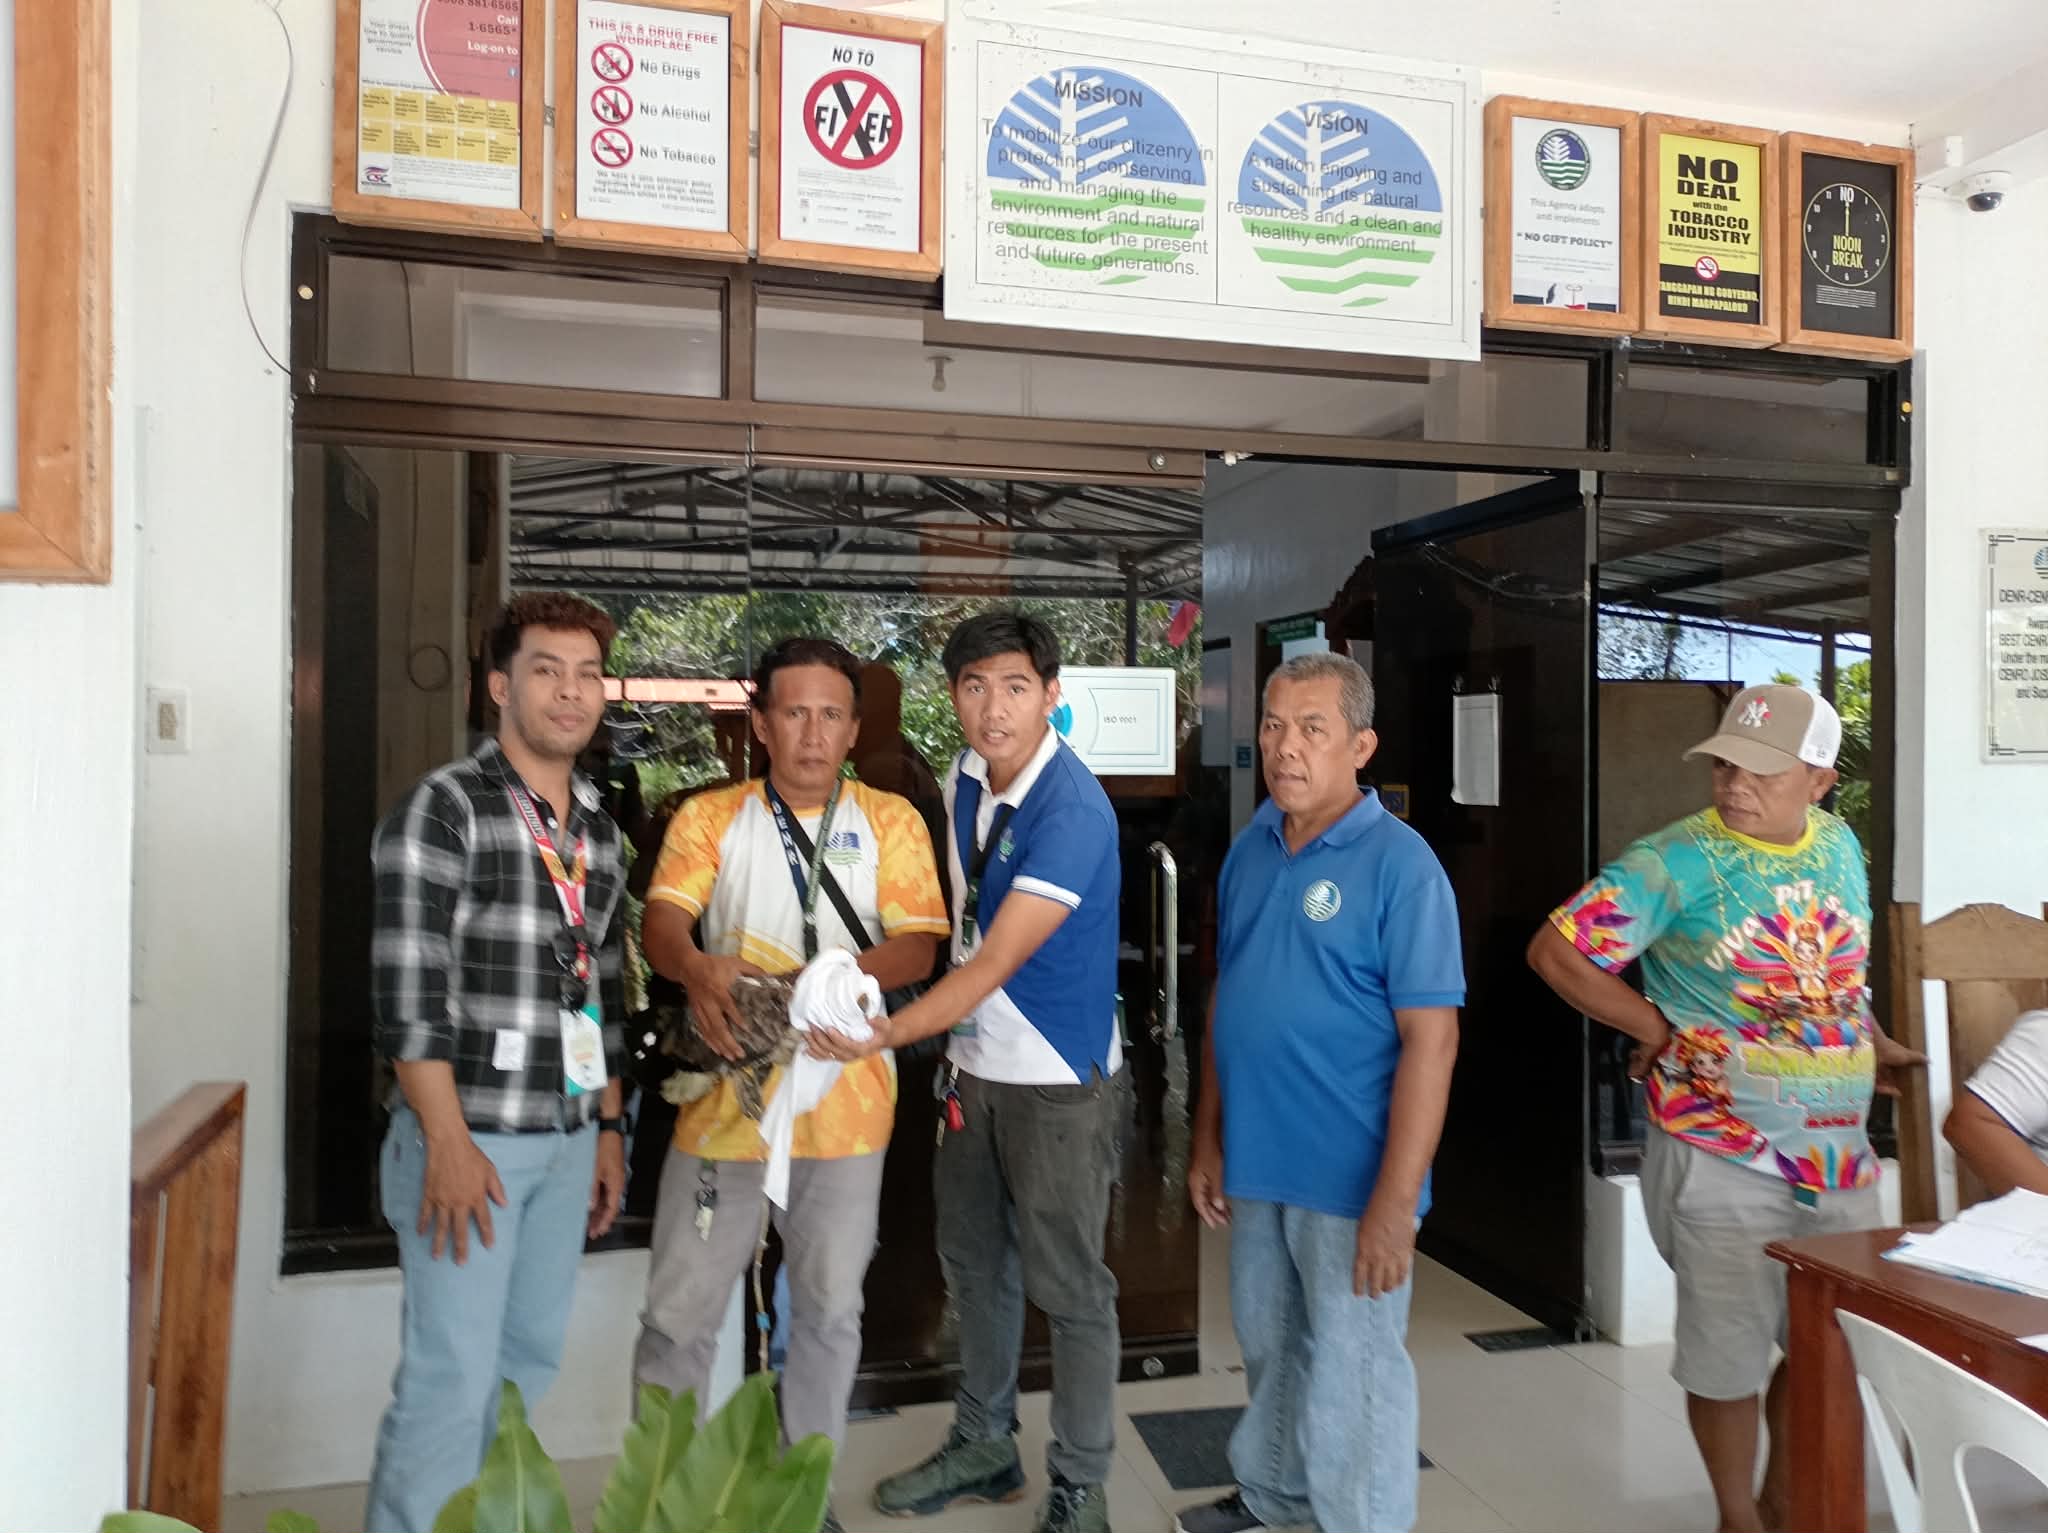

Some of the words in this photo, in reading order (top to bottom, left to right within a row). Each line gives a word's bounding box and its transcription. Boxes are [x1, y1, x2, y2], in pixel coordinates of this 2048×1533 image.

[497, 15, 519, 25] Call
[588, 20, 617, 31] THIS
[621, 22, 633, 33] IS
[636, 24, 645, 34] A
[648, 26, 683, 40] DRUG
[687, 32, 719, 45] FREE
[468, 40, 504, 54] Log-on
[507, 45, 519, 56] to
[616, 34, 693, 52] WORKPLACE
[832, 47, 853, 64] NO
[857, 50, 874, 67] TO
[640, 60, 658, 74] No
[662, 63, 701, 81] Drugs
[1055, 79, 1143, 107] MISSION
[640, 103, 658, 116] No
[661, 104, 711, 123] Alcohol
[1304, 111, 1369, 135] VISION
[982, 118, 1003, 138] To
[1008, 126, 1081, 147] mobilize
[1088, 135, 1116, 150] our
[1122, 138, 1193, 163] citizenry
[1199, 145, 1214, 160] in
[640, 146, 658, 160] No
[662, 147, 717, 166] Tobacco
[366, 174, 388, 183] CSC
[1248, 152, 1259, 167] A
[1264, 153, 1315, 174] nation
[1321, 161, 1387, 185] enjoying
[1392, 168, 1422, 185] and
[1678, 153, 1739, 184] NO
[1020, 174, 1052, 191] and
[1059, 180, 1145, 205] managing
[1152, 188, 1177, 205] the
[1251, 178, 1336, 203] sustaining
[1340, 188, 1359, 203] its
[1364, 191, 1418, 209] natural
[1677, 179, 1741, 202] DEAL
[1825, 190, 1832, 200] 11
[1839, 186, 1855, 203] NO
[991, 197, 1102, 222] environment
[1108, 210, 1139, 226] and
[1146, 213, 1205, 233] natural
[1692, 201, 1712, 210] with
[1713, 203, 1728, 211] the
[1813, 203, 1821, 213] 10
[1227, 198, 1309, 222] resources
[1315, 208, 1344, 225] and
[1350, 214, 1360, 227] a
[1364, 213, 1408, 233] clean
[1412, 218, 1442, 235] and
[1670, 209, 1749, 231] TOBACCO
[987, 219, 1076, 242] resources
[1082, 227, 1104, 244] for
[1111, 231, 1137, 248] the
[1144, 236, 1208, 255] present
[1250, 221, 1311, 247] healthy
[1525, 232, 1540, 242] NO
[1542, 233, 1568, 244] GIFT
[1668, 223, 1751, 245] INDUSTRY
[1807, 223, 1812, 233] 9
[1833, 234, 1862, 253] NOON
[1881, 235, 1885, 243] 3
[995, 244, 1029, 260] and
[1036, 246, 1086, 266] future
[1093, 252, 1200, 276] generations.
[1832, 251, 1864, 269] BREAK
[1875, 258, 1880, 267] 4
[1844, 272, 1849, 281] 6
[1864, 270, 1869, 279] 5
[2000, 588, 2048, 603] DENR-CEN
[2000, 633, 2021, 646] BEST
[2026, 652, 2037, 664] the
[1103, 716, 1117, 724] ISO
[771, 799, 800, 867] DENR
